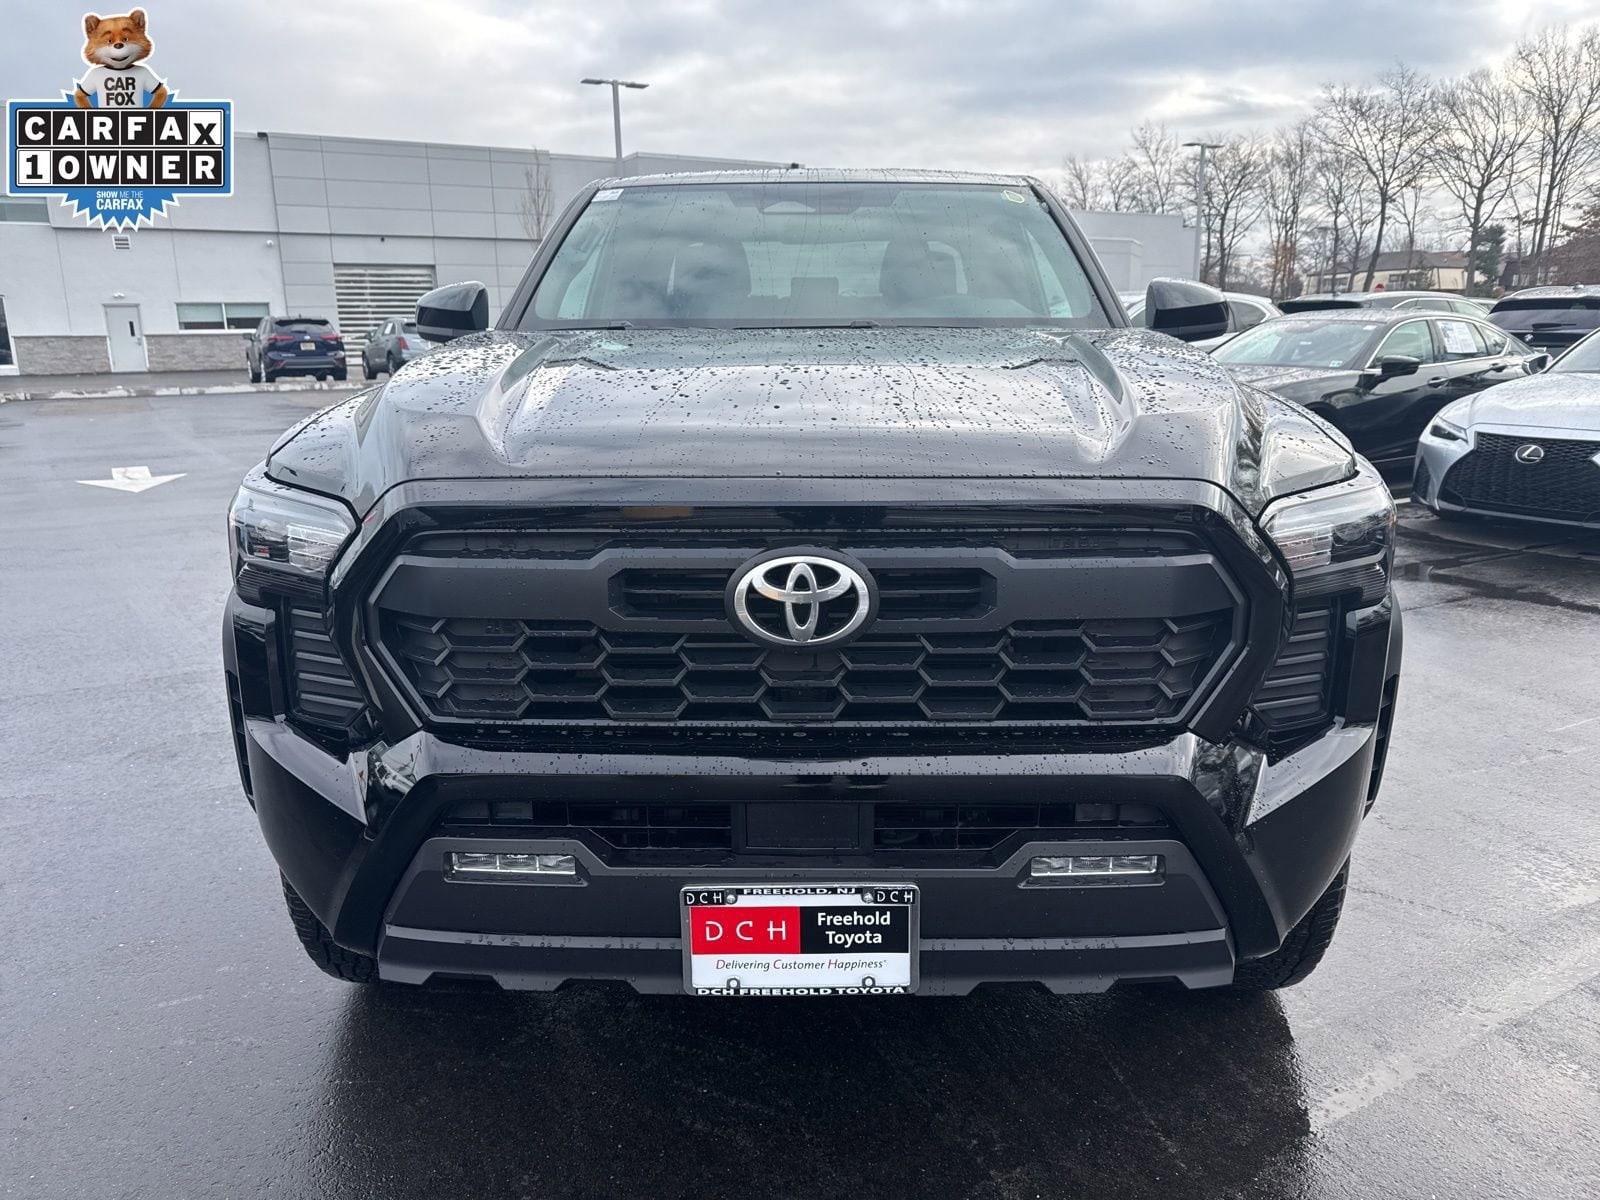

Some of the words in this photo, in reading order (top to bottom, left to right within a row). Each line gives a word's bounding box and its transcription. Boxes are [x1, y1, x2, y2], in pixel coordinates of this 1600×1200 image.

[817, 911, 891, 926] Freehold
[825, 931, 883, 948] Toyota
[716, 959, 770, 971] Delivering
[773, 959, 824, 970] Customer
[836, 986, 905, 995] TOYOTA
